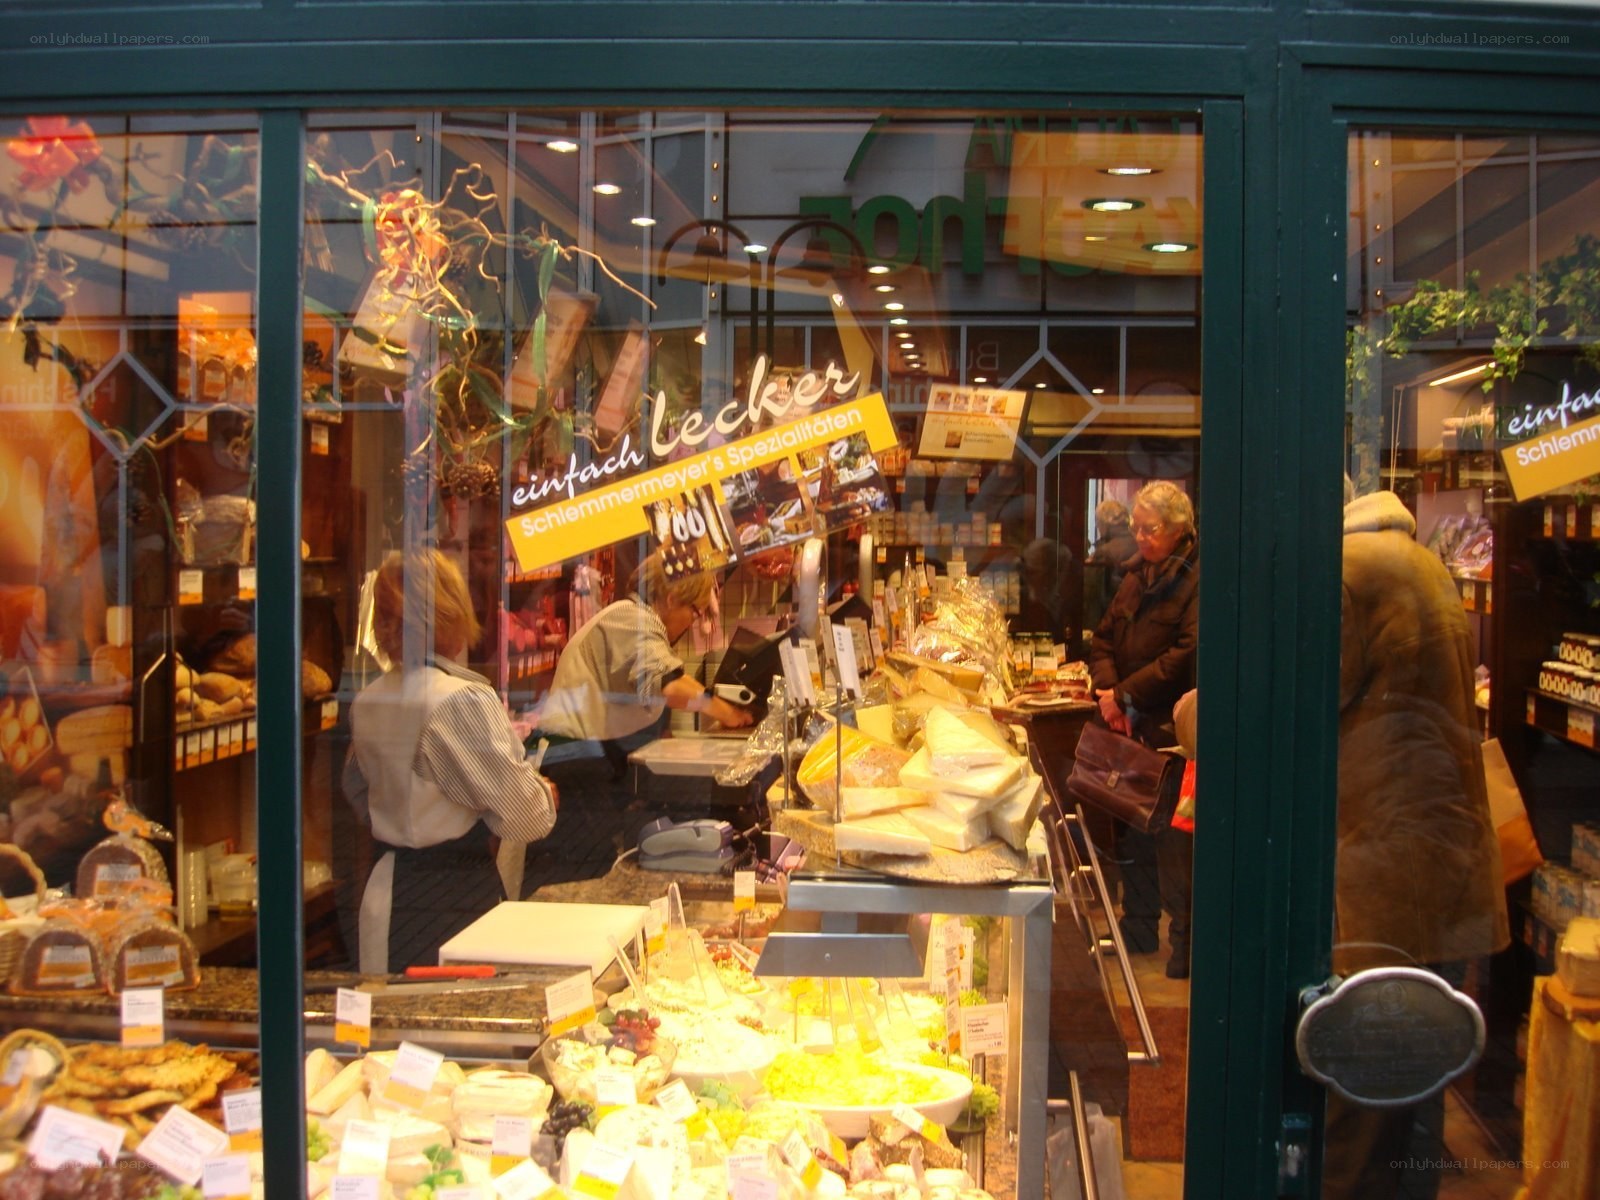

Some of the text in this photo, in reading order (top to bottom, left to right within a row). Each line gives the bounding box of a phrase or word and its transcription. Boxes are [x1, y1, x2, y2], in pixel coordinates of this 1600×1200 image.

[512, 353, 860, 506] einfach lecker
[521, 455, 724, 537] Schlemmermeyer's
